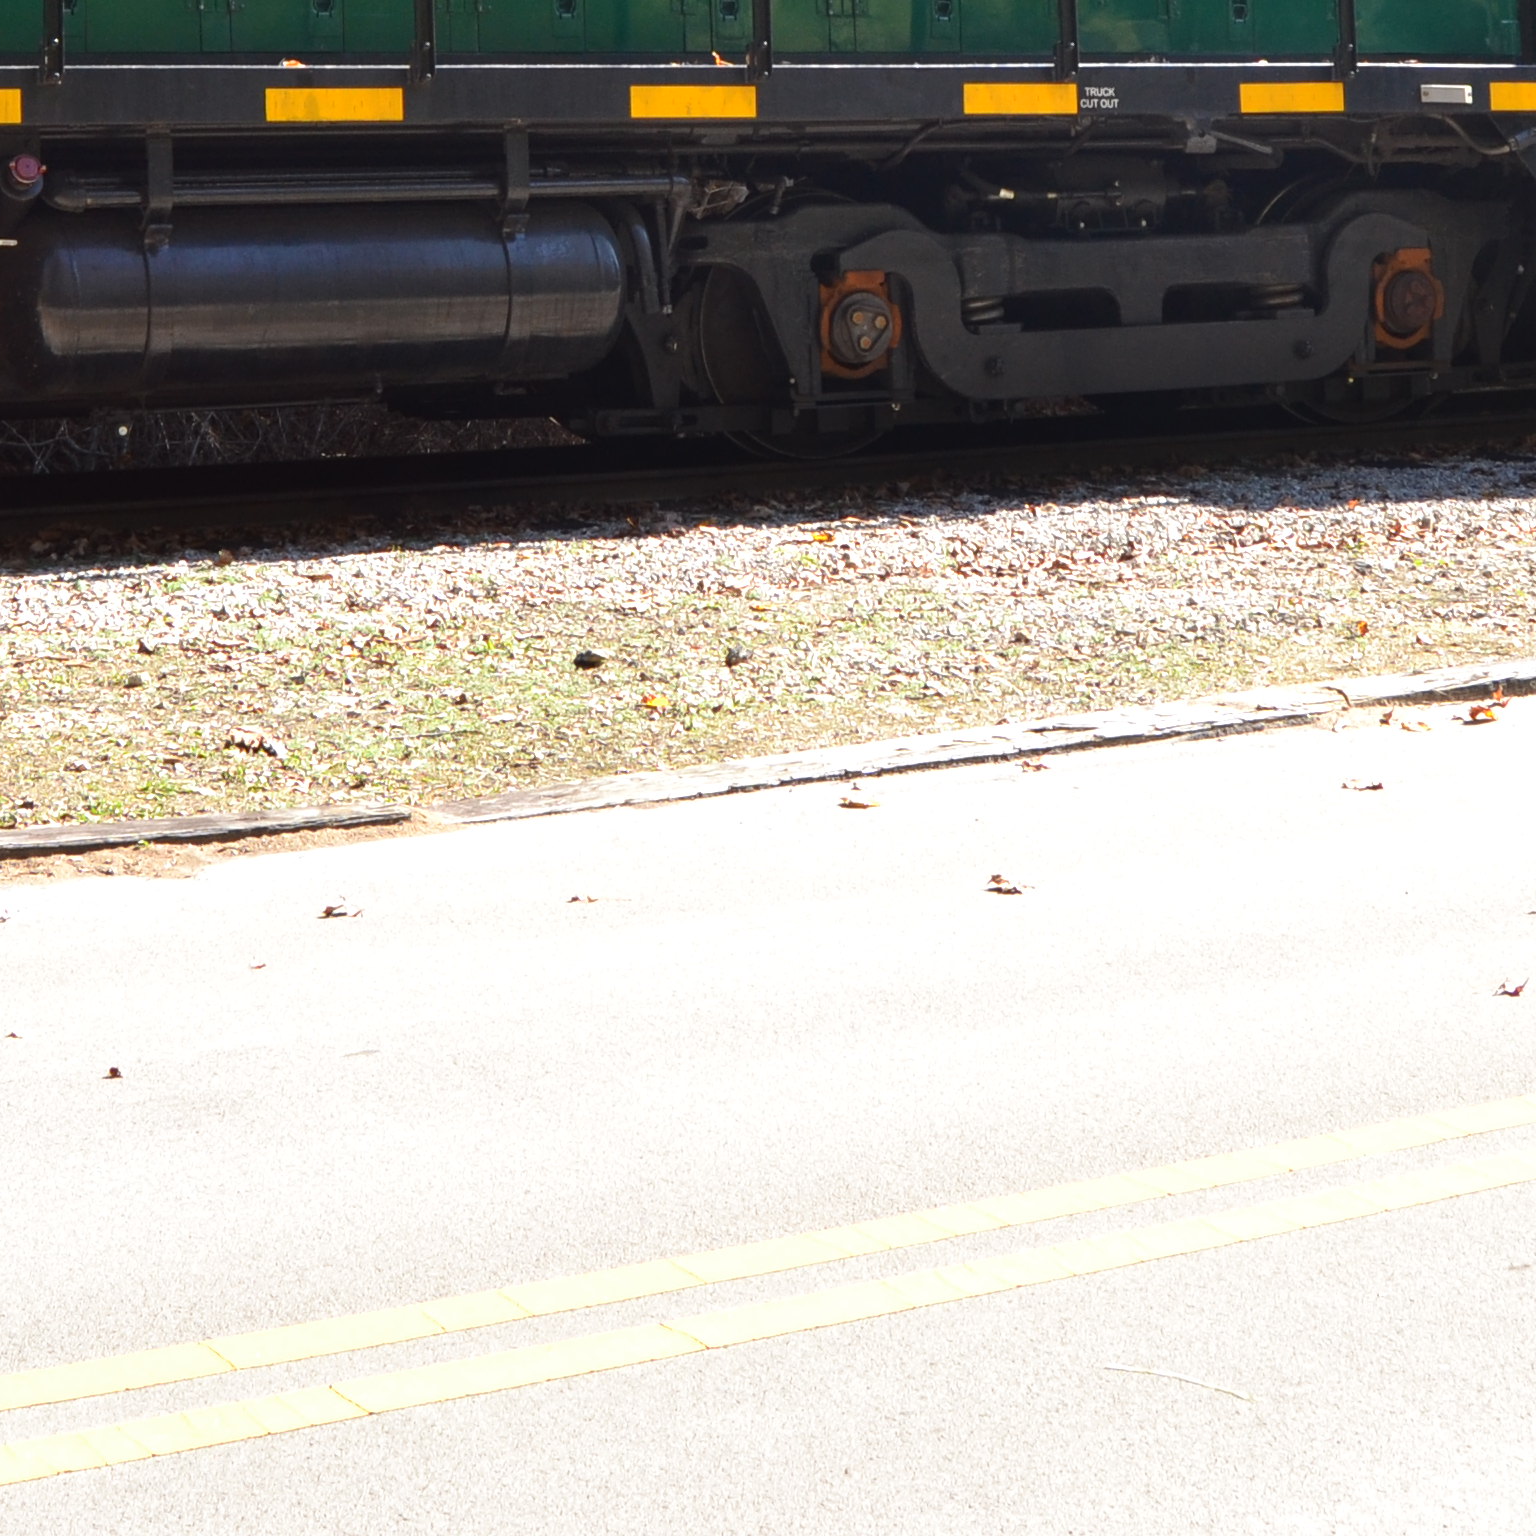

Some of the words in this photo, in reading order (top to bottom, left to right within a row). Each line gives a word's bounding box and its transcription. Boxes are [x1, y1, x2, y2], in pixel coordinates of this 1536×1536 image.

[1084, 86, 1115, 97] TRUCK
[1080, 98, 1098, 109] CUT
[1100, 98, 1120, 109] OUT
